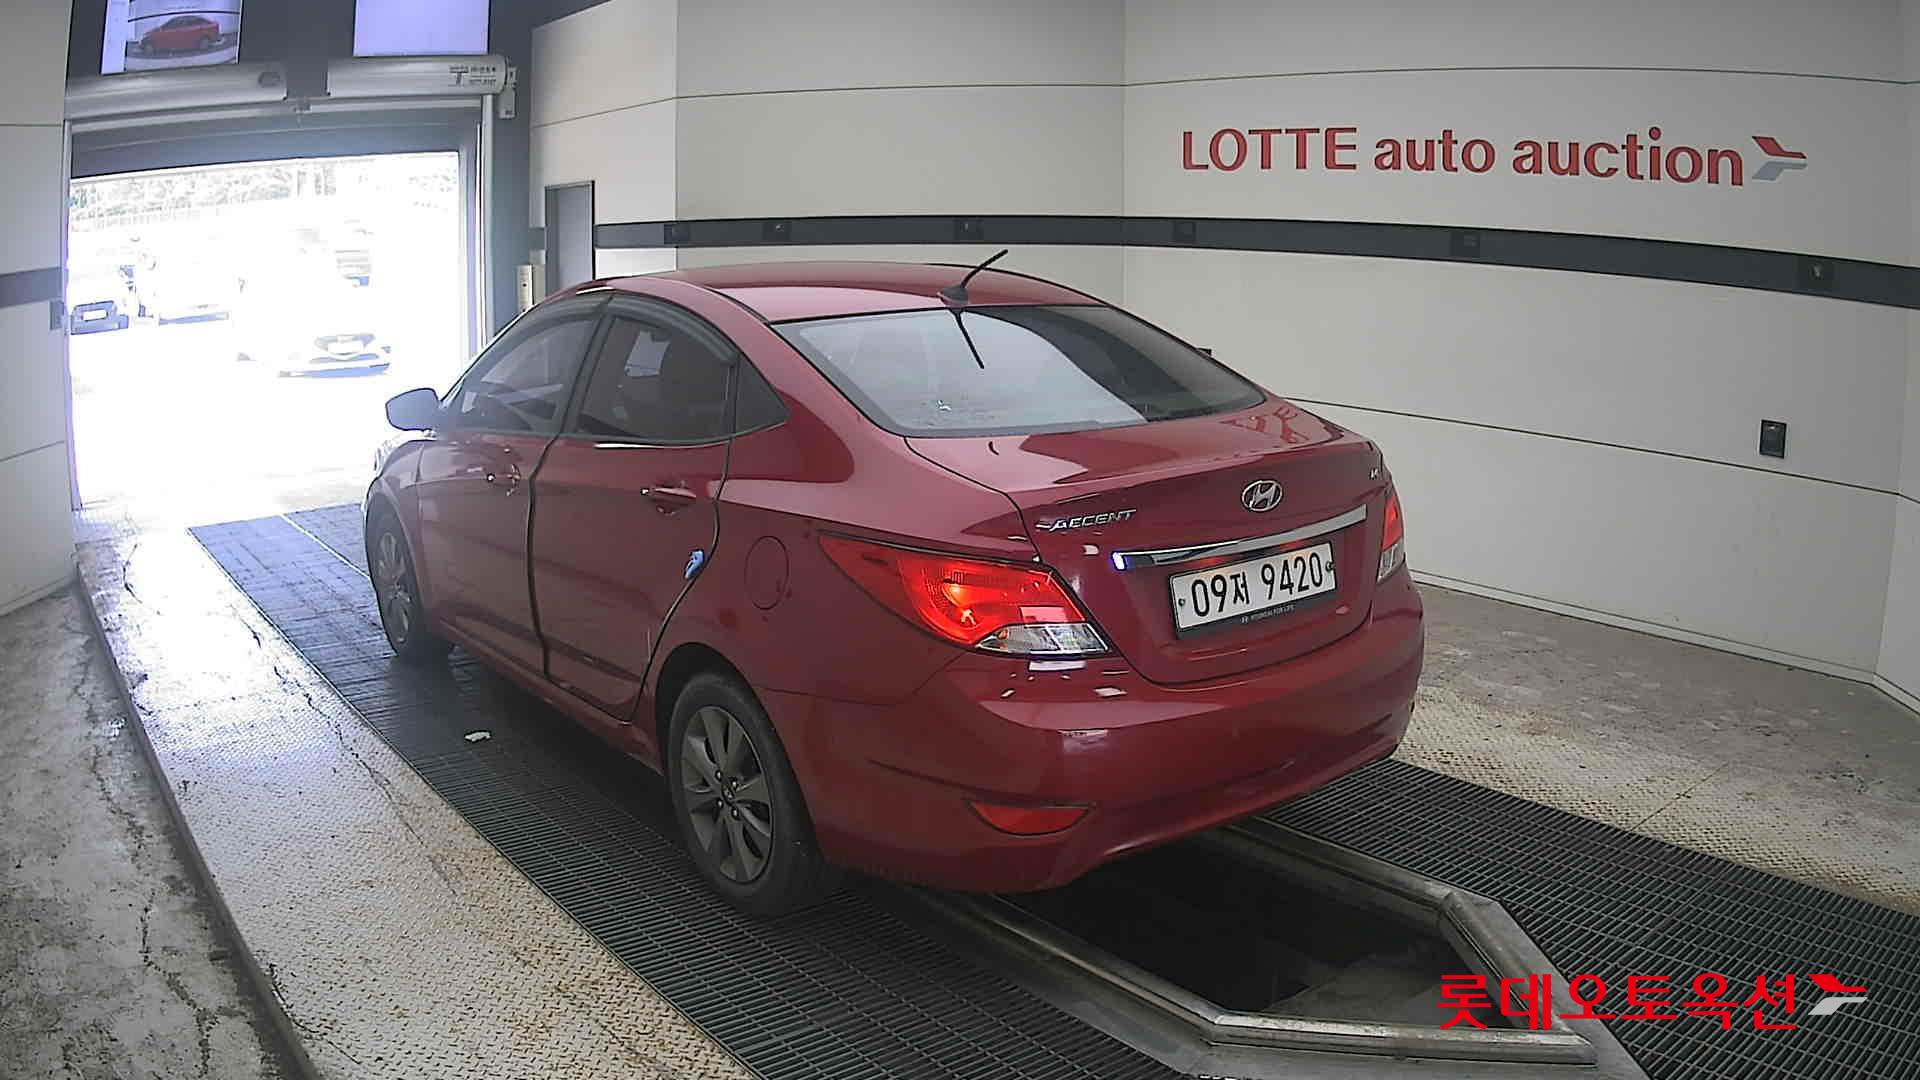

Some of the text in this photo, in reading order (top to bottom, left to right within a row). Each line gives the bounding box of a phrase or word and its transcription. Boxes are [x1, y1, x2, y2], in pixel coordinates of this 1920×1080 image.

[1183, 127, 1743, 186] LOTTE auto auction
[1191, 553, 1323, 617] 09저 9420
